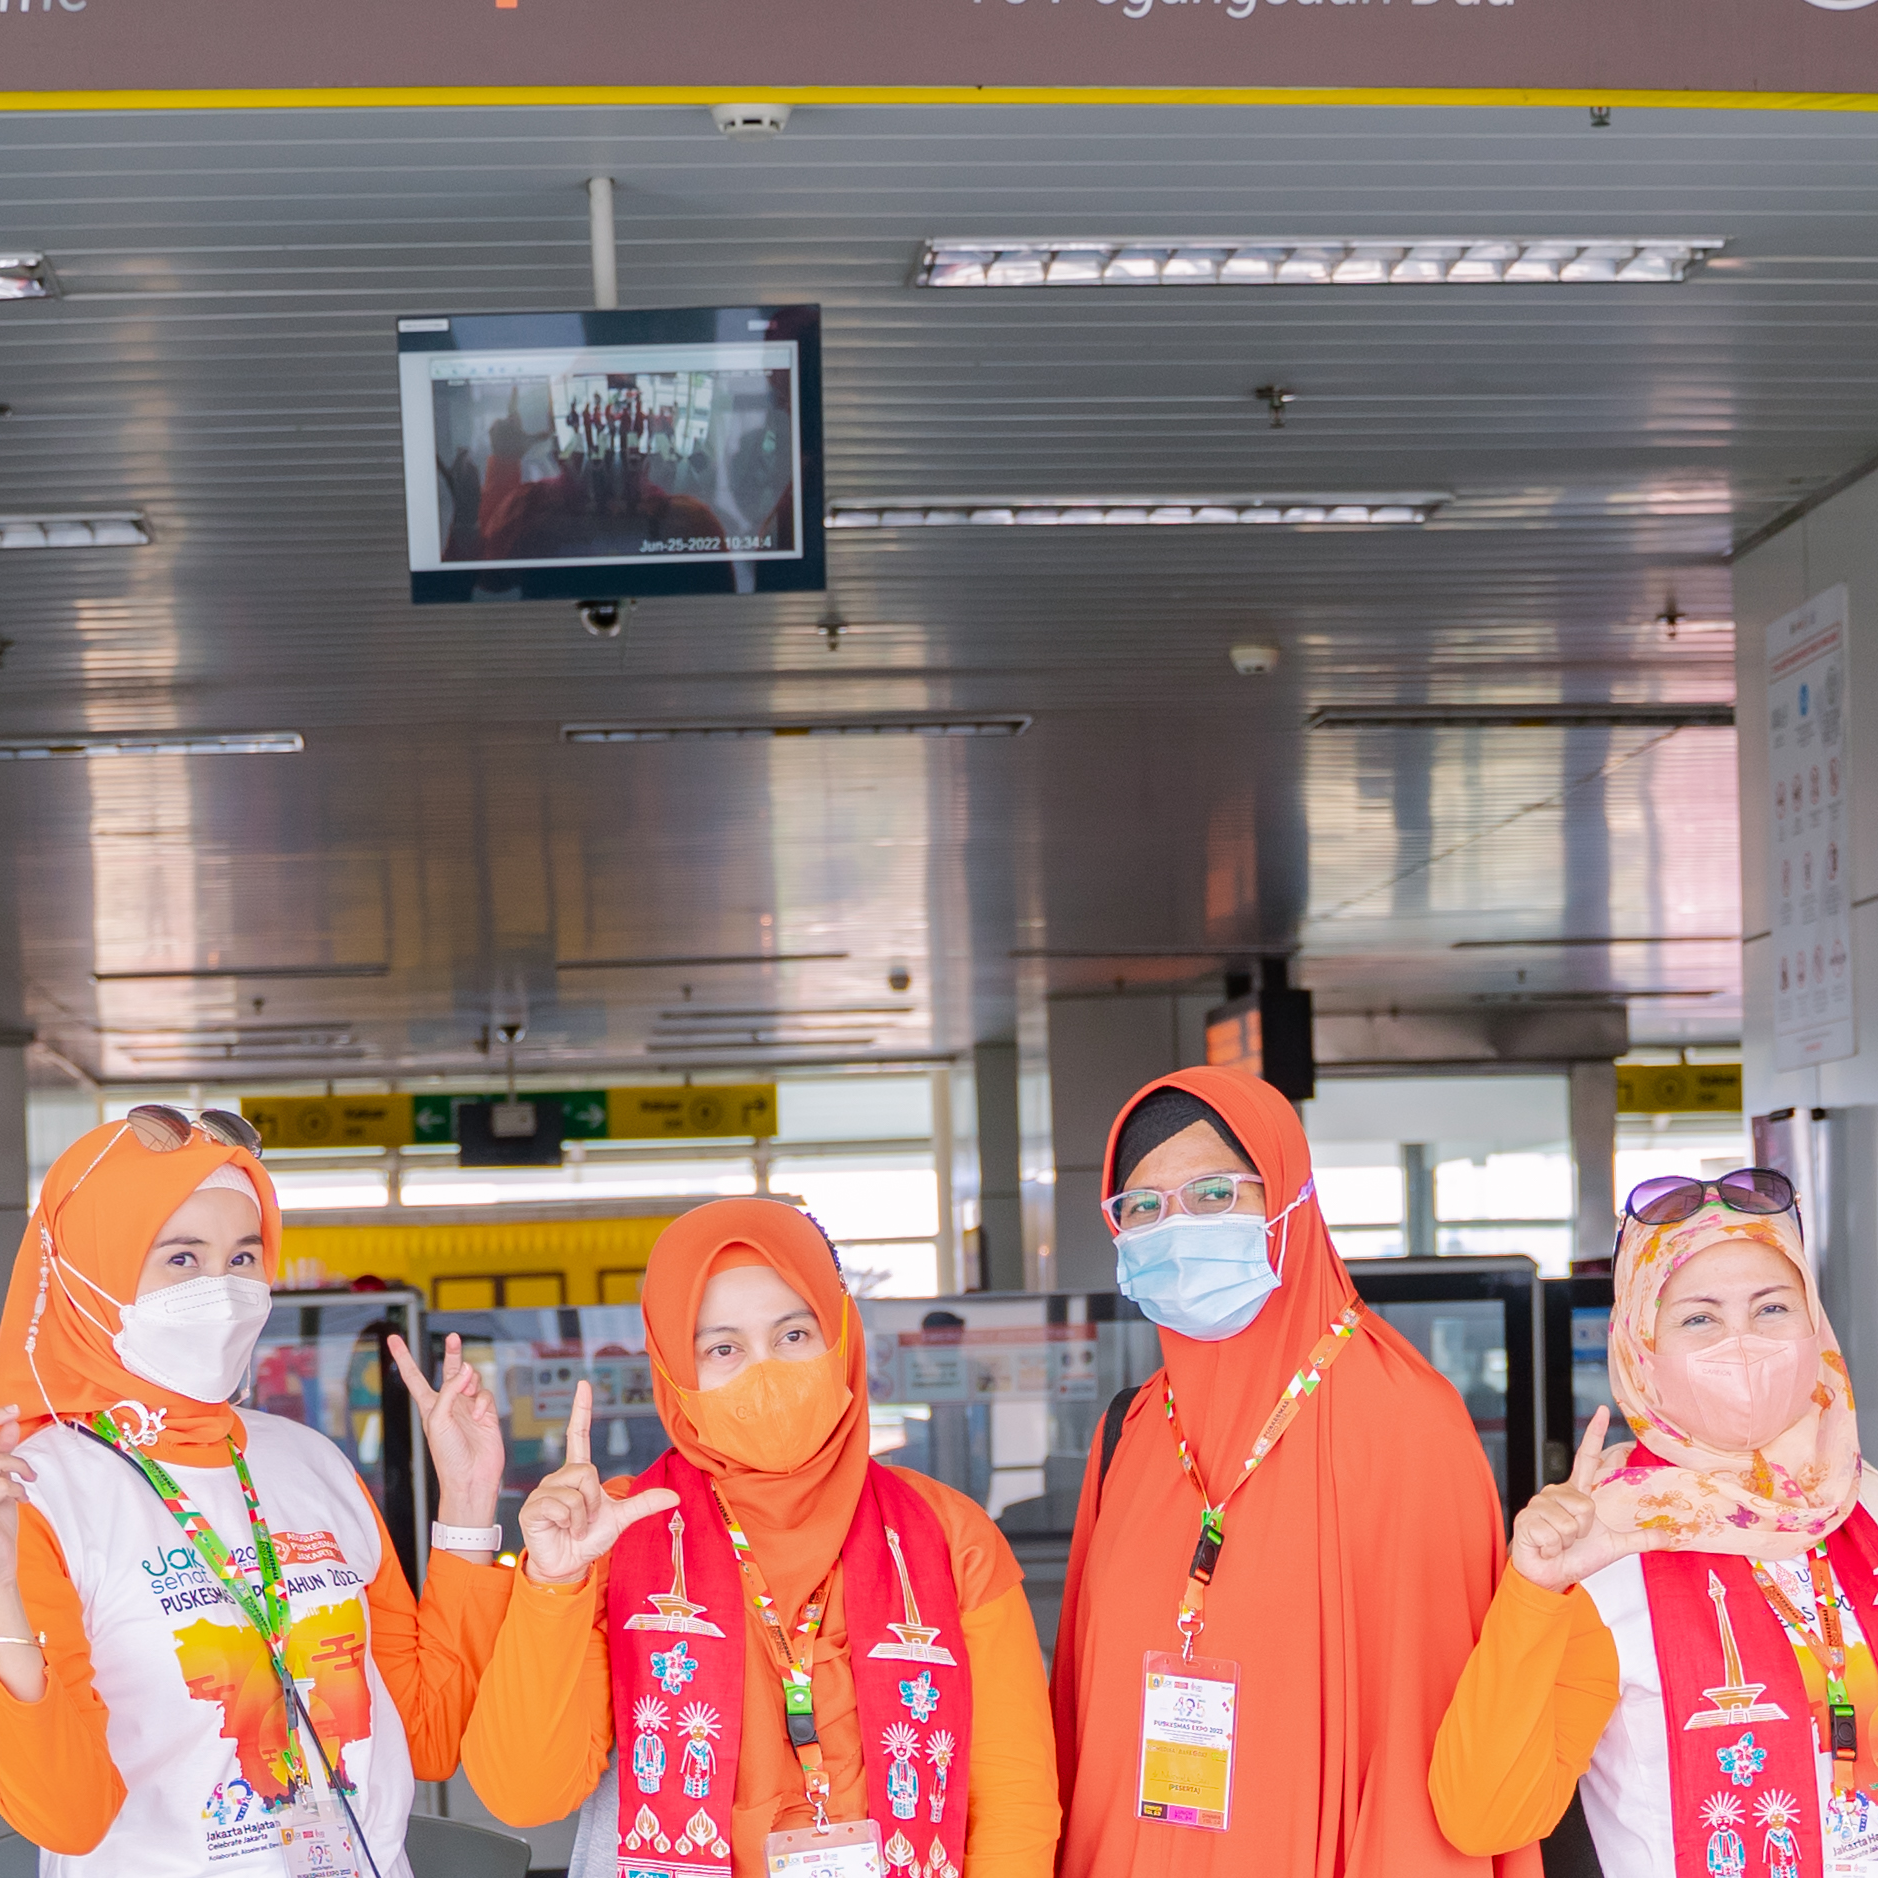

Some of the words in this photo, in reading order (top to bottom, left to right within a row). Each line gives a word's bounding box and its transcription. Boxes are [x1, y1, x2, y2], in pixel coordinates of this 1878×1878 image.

[639, 537, 721, 552] Jun-25-2022
[142, 1546, 205, 1577] Jak
[151, 1567, 212, 1594] sehat
[286, 1573, 327, 1597] AHUN
[327, 1568, 365, 1588] 2022
[1154, 1719, 1190, 1730] PUSKESMAS
[1191, 1724, 1208, 1732] EXPO
[1209, 1727, 1223, 1735] 2022
[206, 1826, 243, 1843] Jakarta
[244, 1819, 282, 1836] Hajatan
[208, 1838, 242, 1851] Celebrate
[243, 1833, 268, 1844] Jakarta
[1832, 1837, 1867, 1857] Jakarta
